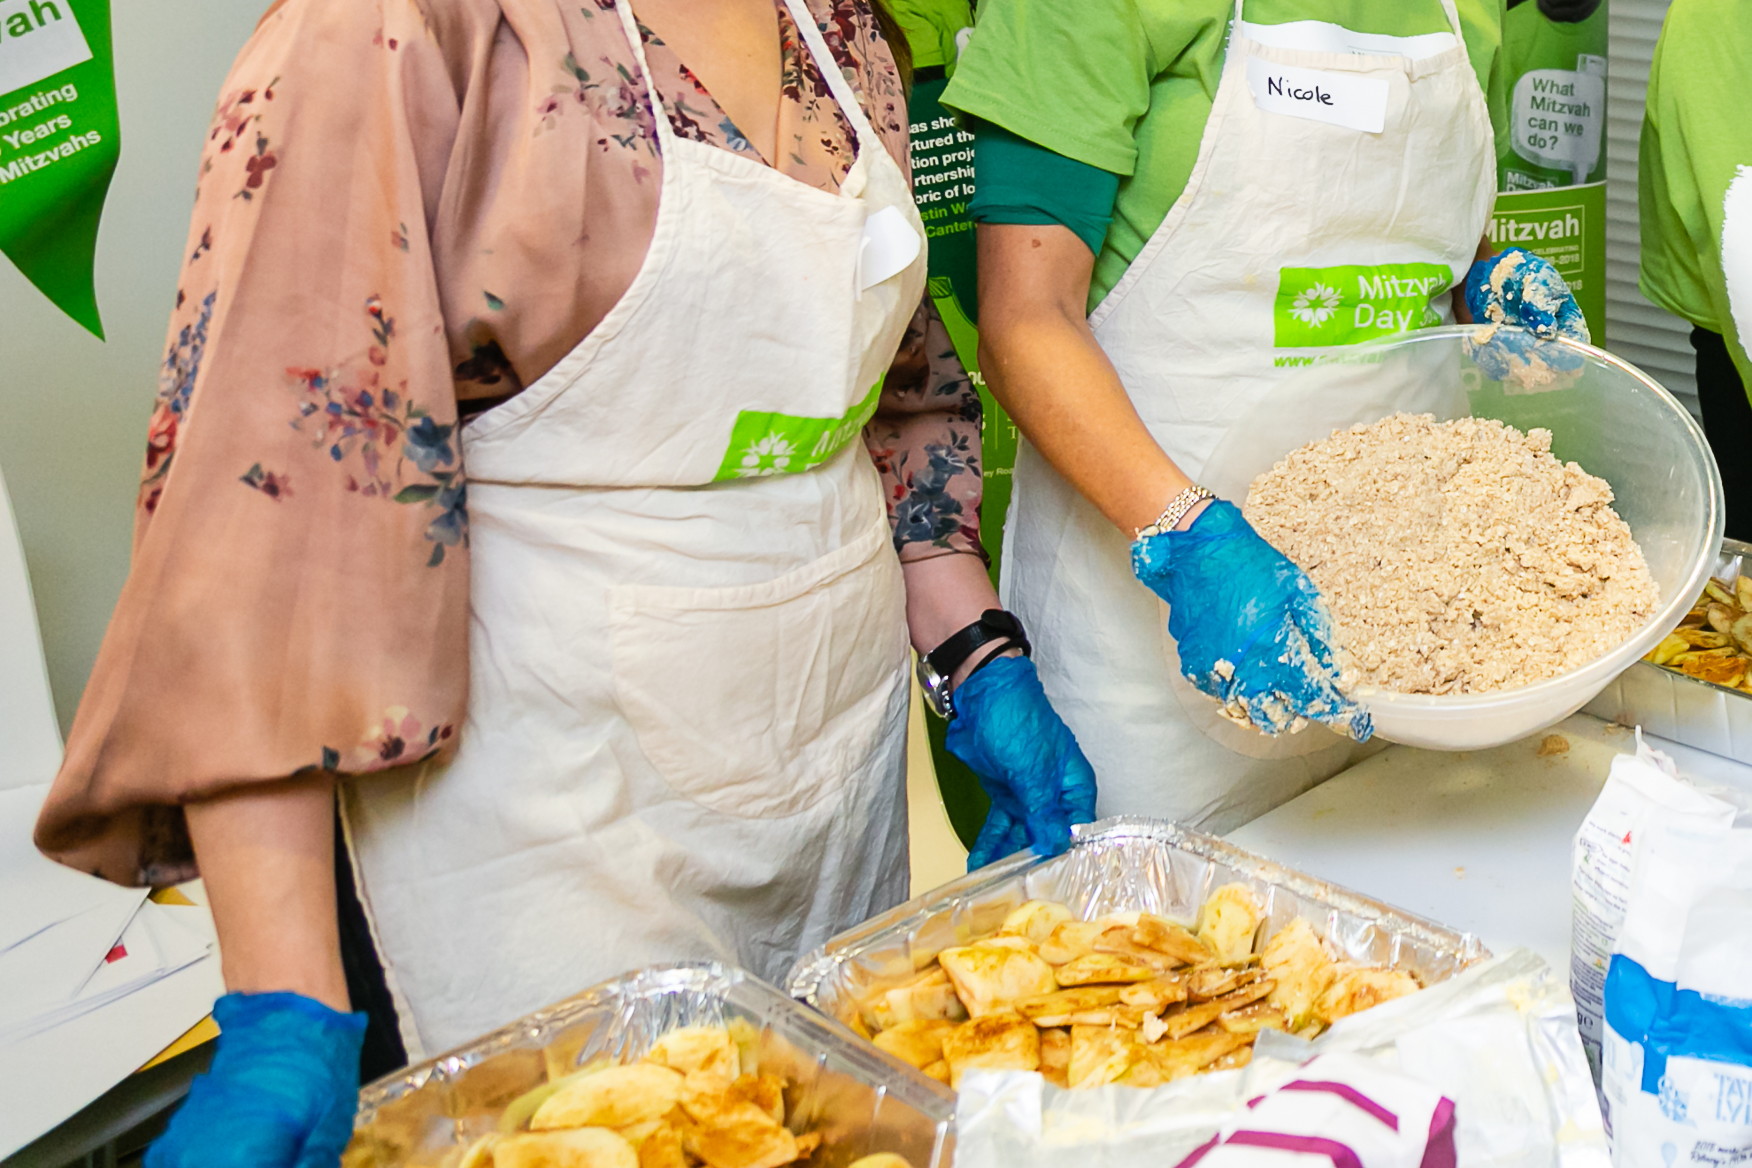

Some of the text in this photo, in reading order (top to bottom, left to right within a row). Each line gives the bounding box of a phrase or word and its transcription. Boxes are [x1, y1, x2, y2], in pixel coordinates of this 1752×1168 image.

[1267, 76, 1334, 106] Nicole
[1531, 77, 1575, 97] What
[1529, 95, 1591, 118] Mitzvah
[3, 114, 72, 151] Years
[909, 121, 928, 134] as
[1527, 116, 1585, 136] can we
[910, 133, 954, 152] rtured
[1527, 133, 1559, 151] do?
[0, 130, 102, 184] Mitzvahs
[944, 185, 960, 200] of
[1488, 214, 1580, 243] Mitzvah
[1358, 273, 1447, 300] Mitzvah
[1354, 303, 1414, 332] Day
